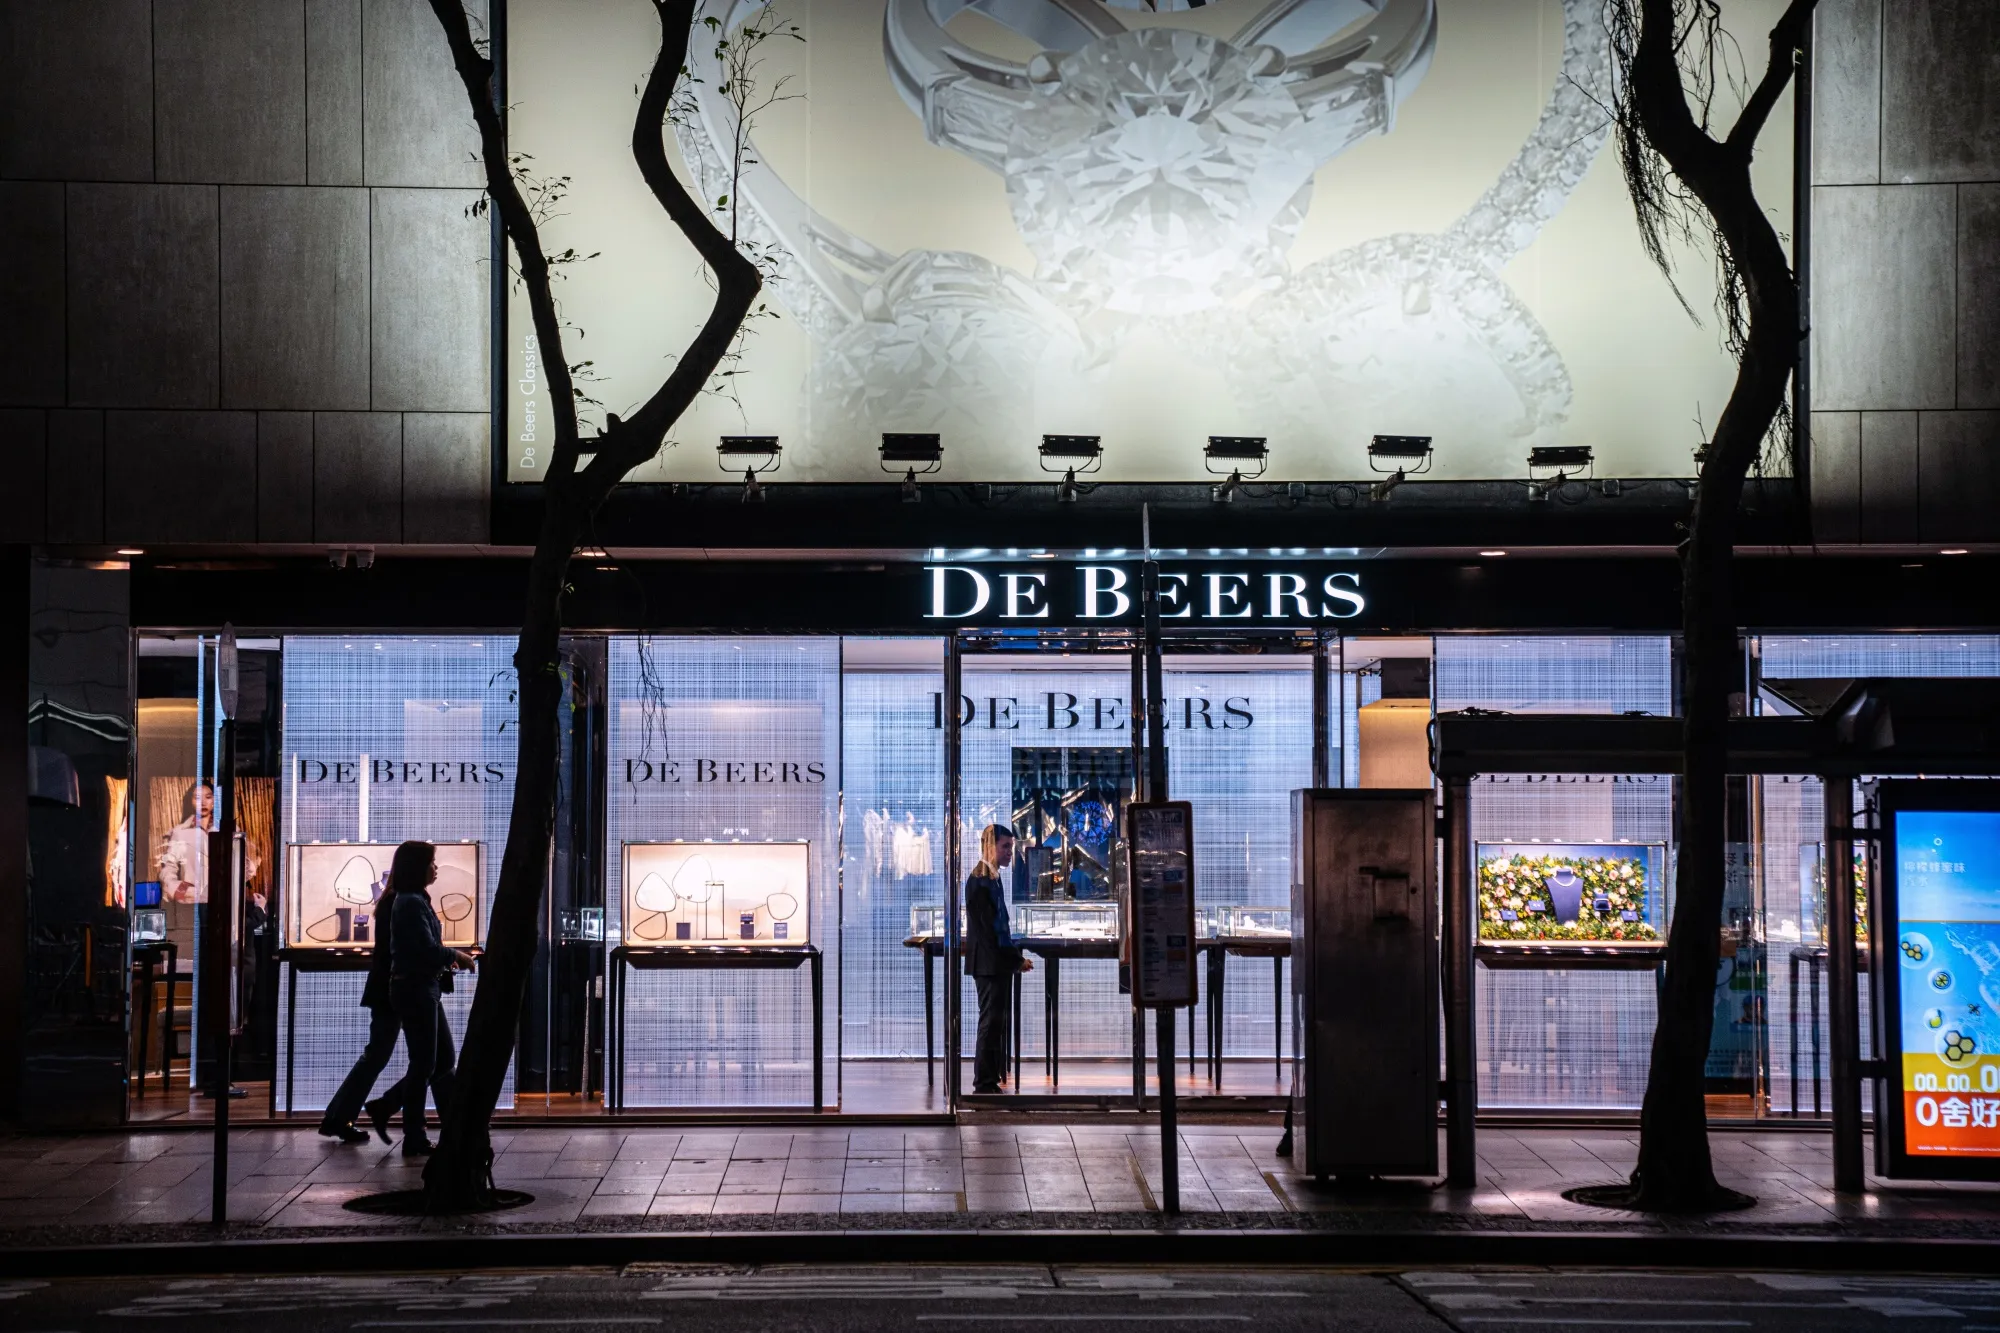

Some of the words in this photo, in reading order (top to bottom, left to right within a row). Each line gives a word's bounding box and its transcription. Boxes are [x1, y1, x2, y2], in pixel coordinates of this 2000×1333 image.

[518, 334, 537, 396] Classics
[520, 400, 536, 441] Beers
[520, 447, 536, 468] De
[924, 566, 1050, 619] DE
[926, 691, 1020, 730] DE
[299, 758, 357, 784] DE
[372, 758, 505, 784] BEERS
[622, 758, 681, 784] DE
[693, 758, 827, 784] BEERS
